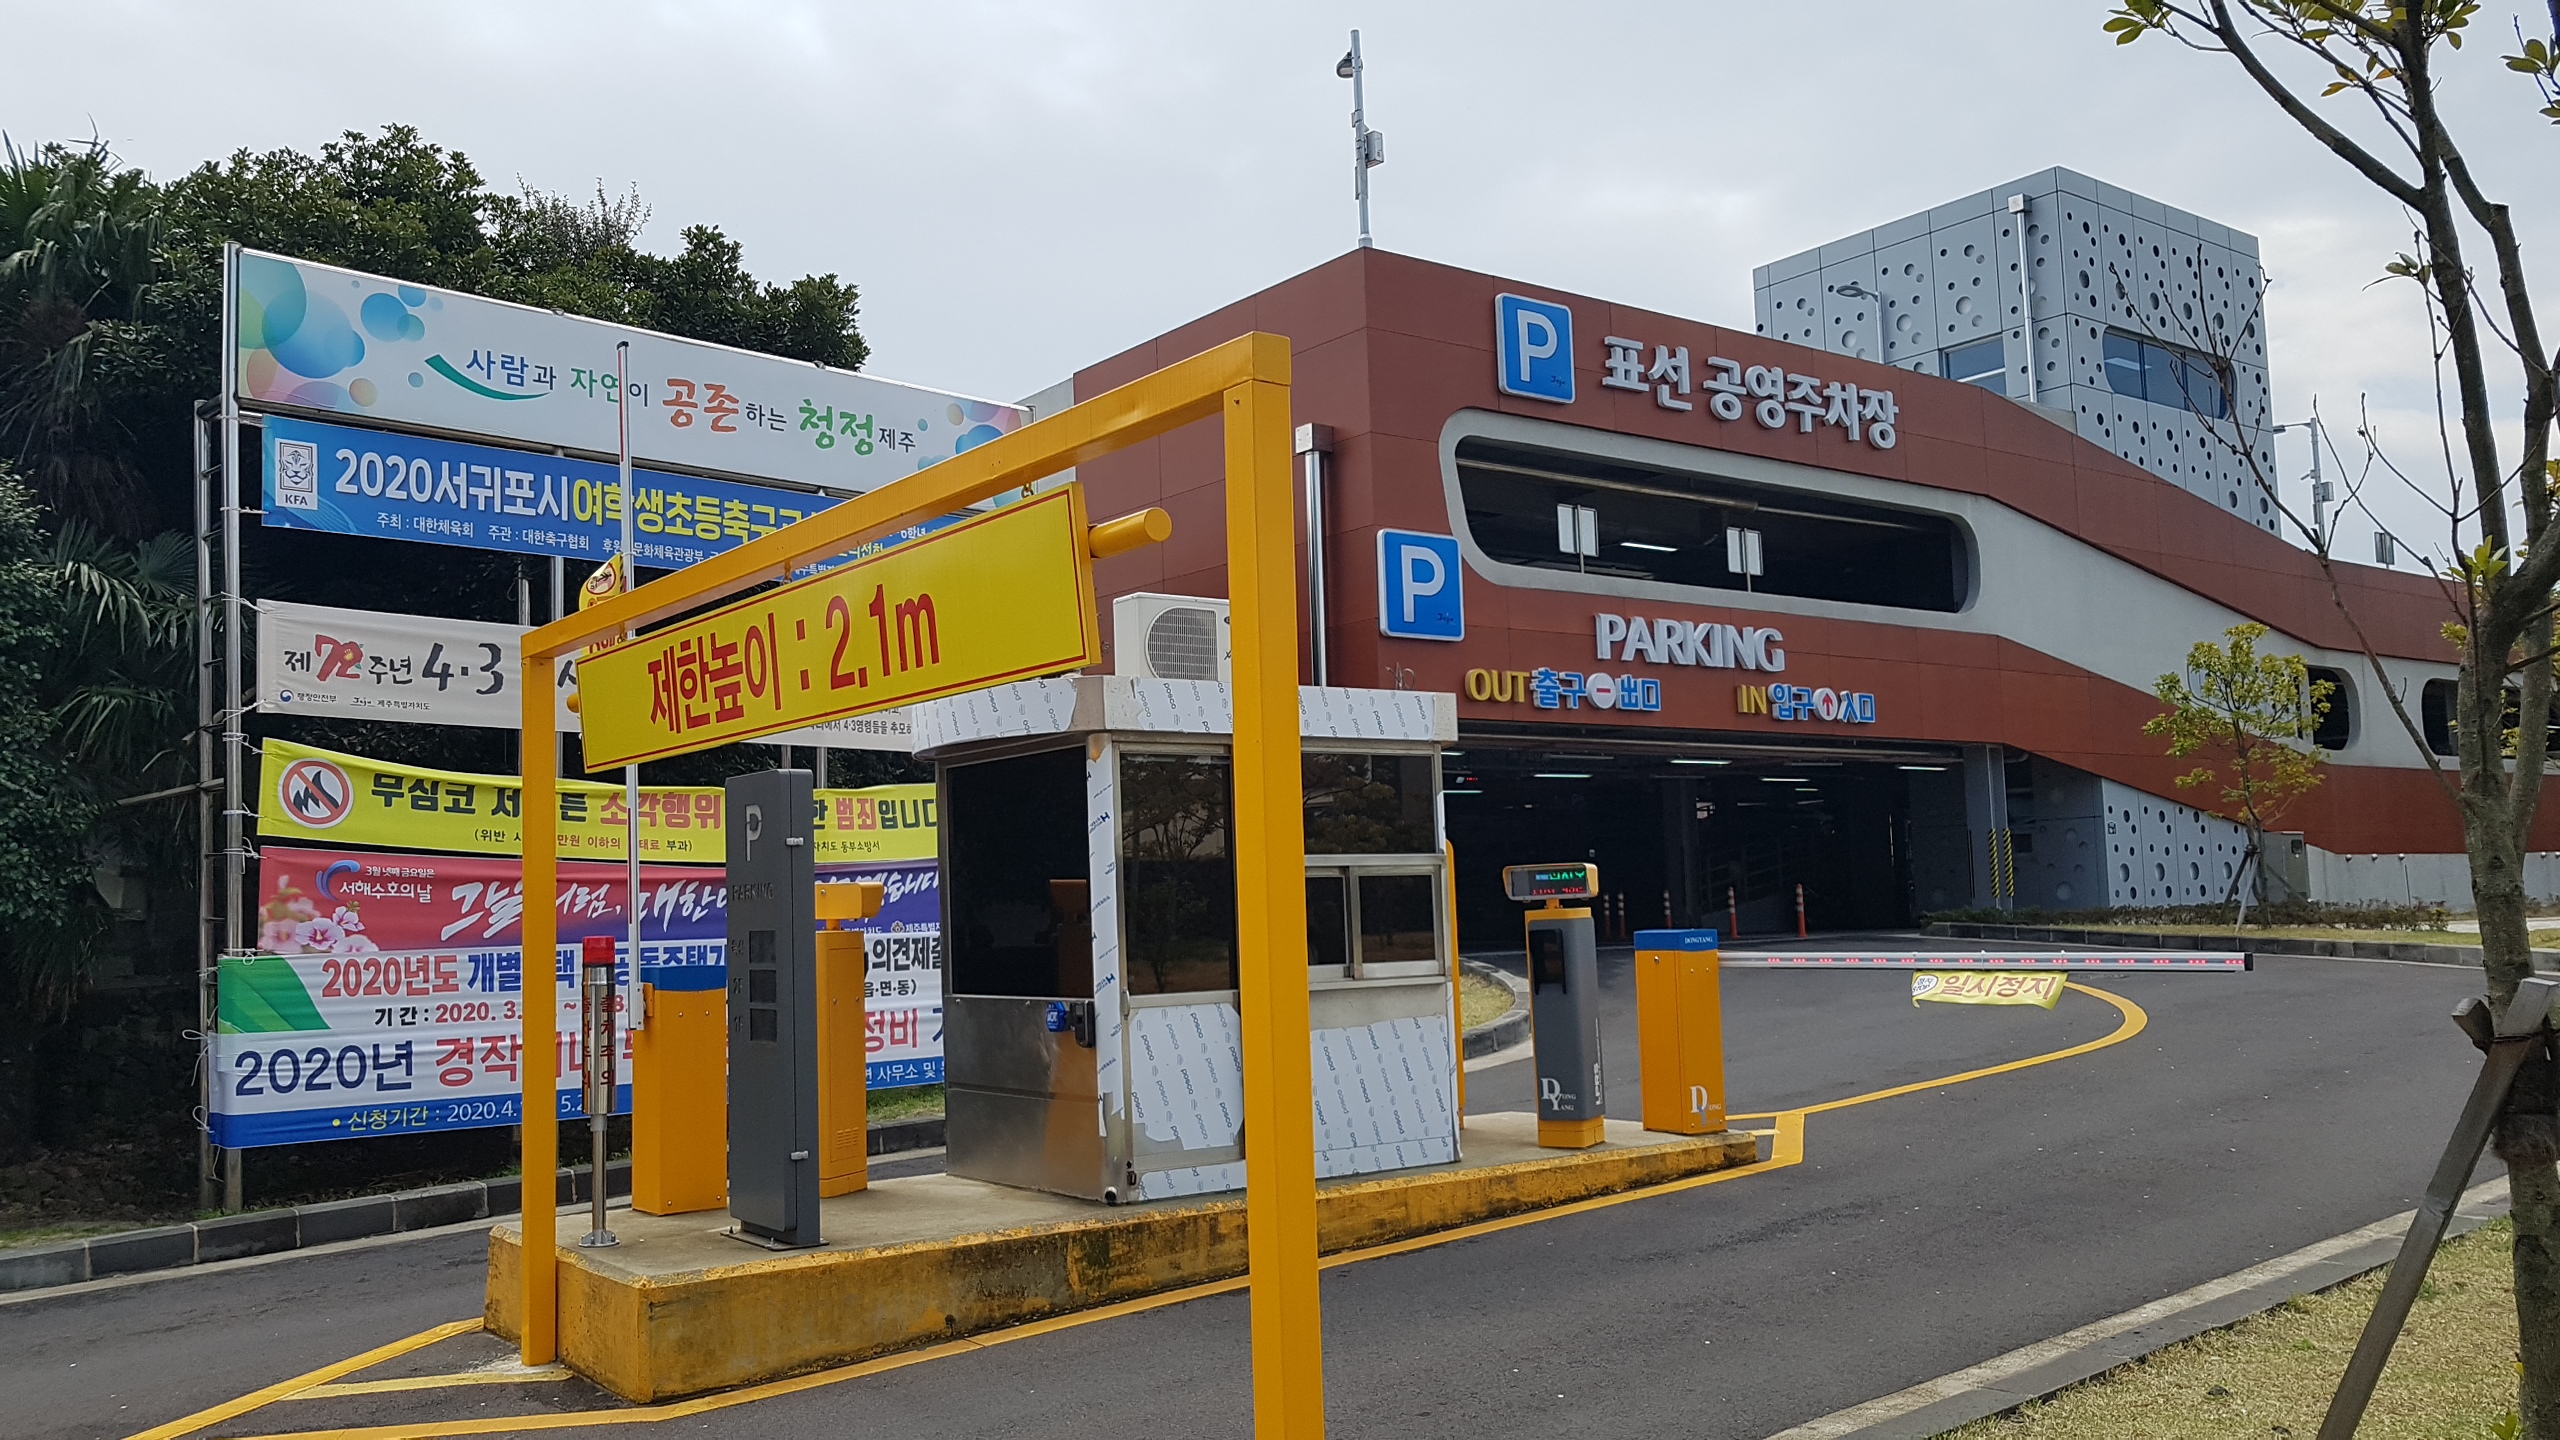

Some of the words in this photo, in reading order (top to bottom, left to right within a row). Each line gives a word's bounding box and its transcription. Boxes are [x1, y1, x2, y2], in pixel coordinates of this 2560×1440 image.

[1517, 309, 1557, 382] P
[466, 349, 557, 391] 사람과
[570, 366, 649, 407] 자연이
[1602, 336, 1693, 411] 표선
[1703, 356, 1899, 450] 공영주차장
[285, 494, 308, 506] KFA
[413, 516, 474, 538] 대한체육회
[522, 528, 589, 551] 대한축구협회
[1401, 545, 1446, 623] P
[1595, 613, 1786, 672] PARKING
[647, 613, 782, 734] 제한높이
[1164, 683, 1177, 709] posco
[1415, 695, 1427, 720] posco
[1373, 711, 1384, 735] posco
[1394, 703, 1406, 728] posco
[371, 773, 476, 814] 무심코
[600, 791, 722, 830] 소각행위
[840, 840, 880, 854] 동부소방서
[732, 882, 774, 900] PARKING
[1684, 936, 1713, 944] DONGYANG
[322, 955, 459, 998] 2020년도
[1940, 974, 2058, 1000] 일시정지
[1166, 1024, 1179, 1050] posco
[1191, 1013, 1204, 1038] posco
[1367, 1025, 1379, 1050] posco
[1141, 1035, 1155, 1061] posco
[1229, 1046, 1242, 1072] posco
[1324, 1046, 1335, 1071] posco
[1423, 1047, 1433, 1071] posco
[235, 1040, 413, 1096] 2020년
[1205, 1058, 1218, 1084] posco
[1381, 1068, 1392, 1092] posco
[1402, 1057, 1413, 1082] posco
[1156, 1080, 1169, 1107] posco
[1181, 1069, 1194, 1095] posco
[1360, 1078, 1371, 1103] posco
[348, 1109, 428, 1132] 신청기간
[877, 1064, 919, 1083] 사무소
[1131, 1092, 1144, 1118] posco
[1337, 1090, 1349, 1114] posco
[1435, 1088, 1446, 1113] posco
[1219, 1102, 1232, 1128] posco
[1315, 1100, 1327, 1126] posco
[1394, 1110, 1405, 1134] posco
[1415, 1100, 1426, 1123] posco
[1195, 1113, 1208, 1140] posco
